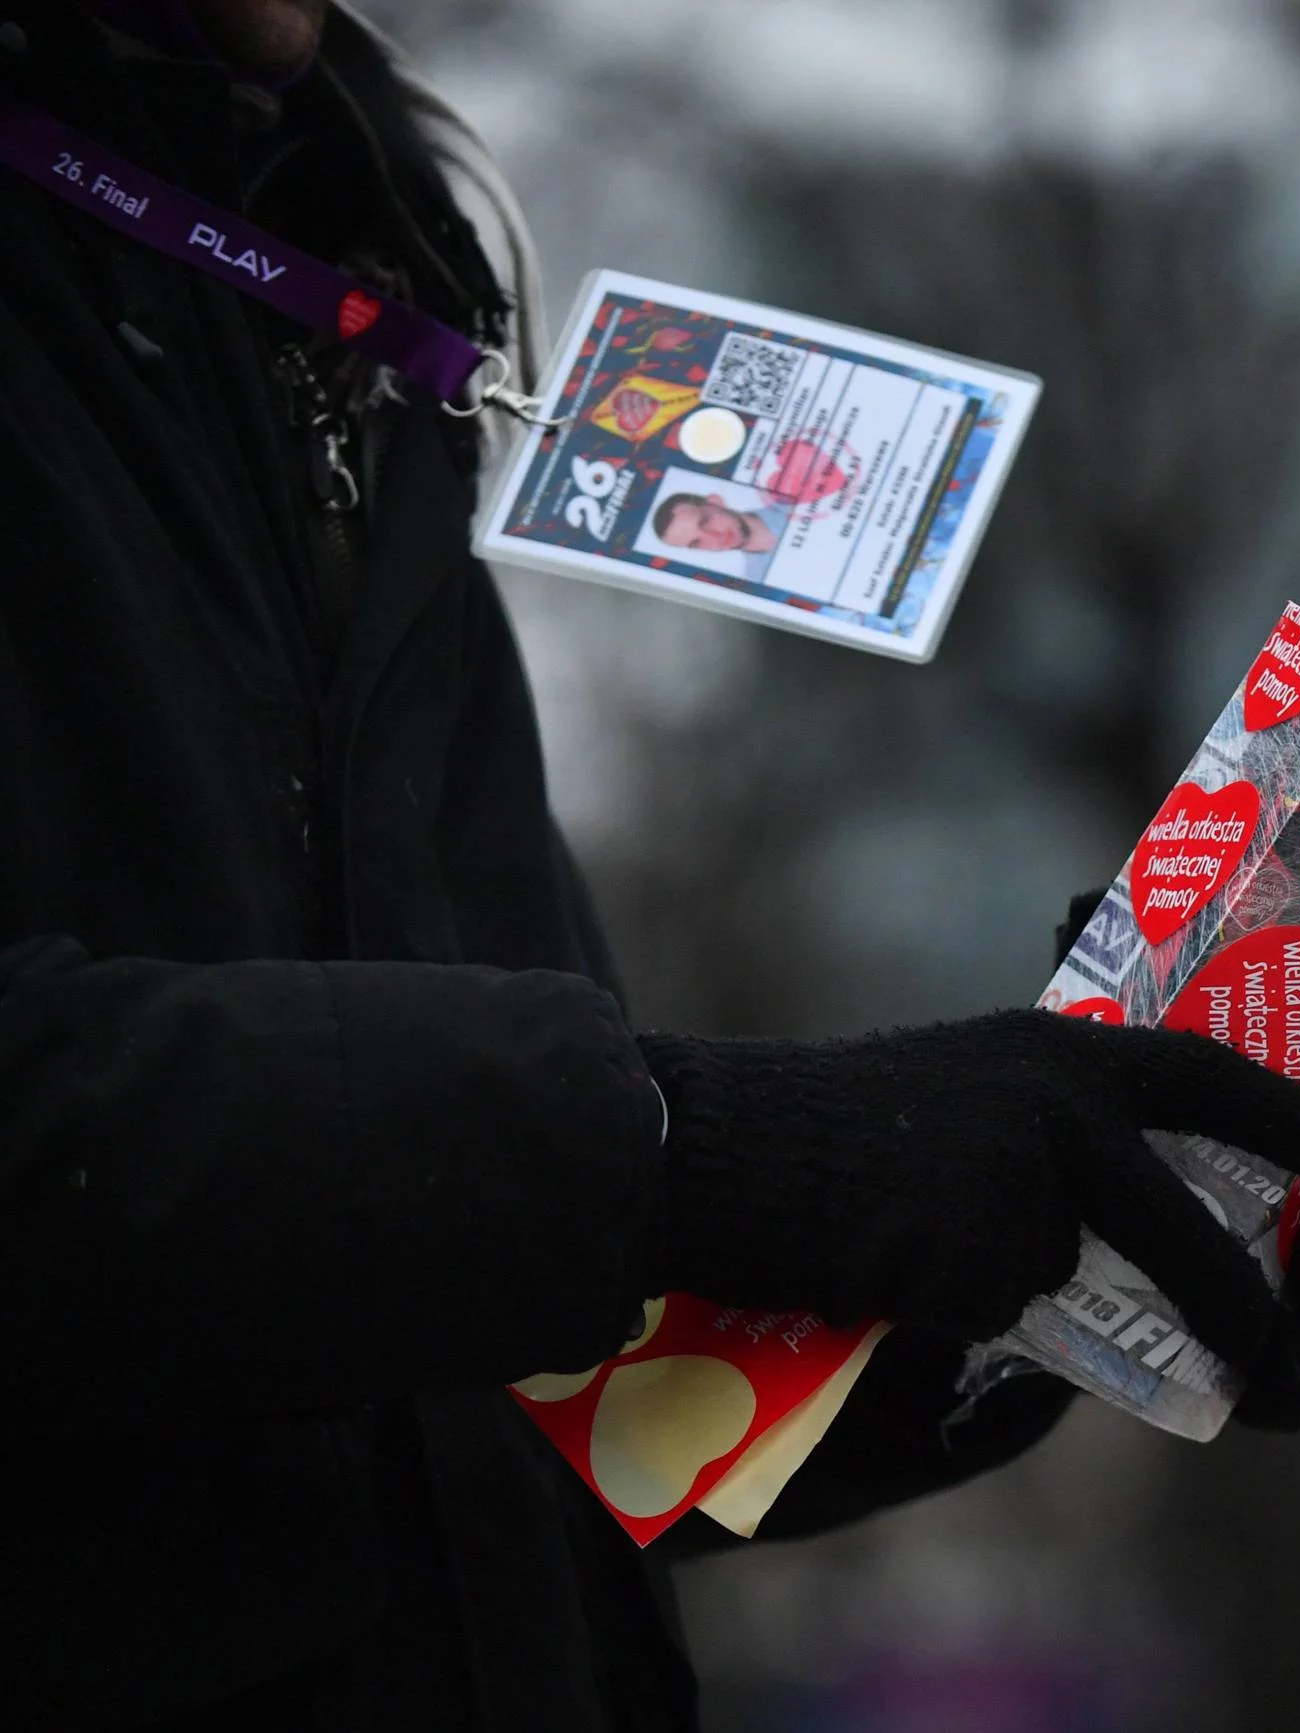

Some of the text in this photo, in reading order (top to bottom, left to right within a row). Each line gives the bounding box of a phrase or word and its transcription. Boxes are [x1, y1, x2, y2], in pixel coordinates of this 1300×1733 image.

[52, 152, 84, 187] 26.
[188, 223, 287, 282] PLAY
[565, 455, 617, 542] 26
[1250, 668, 1299, 717] pomocy
[1147, 808, 1246, 843] wielka orkiestra
[1142, 846, 1226, 890] świątecznej
[1142, 887, 1199, 919] pomocy
[1085, 912, 1134, 951] AY
[1200, 986, 1232, 1047] pomo
[1238, 961, 1278, 1067] świąteczn
[1061, 1280, 1120, 1322] 018
